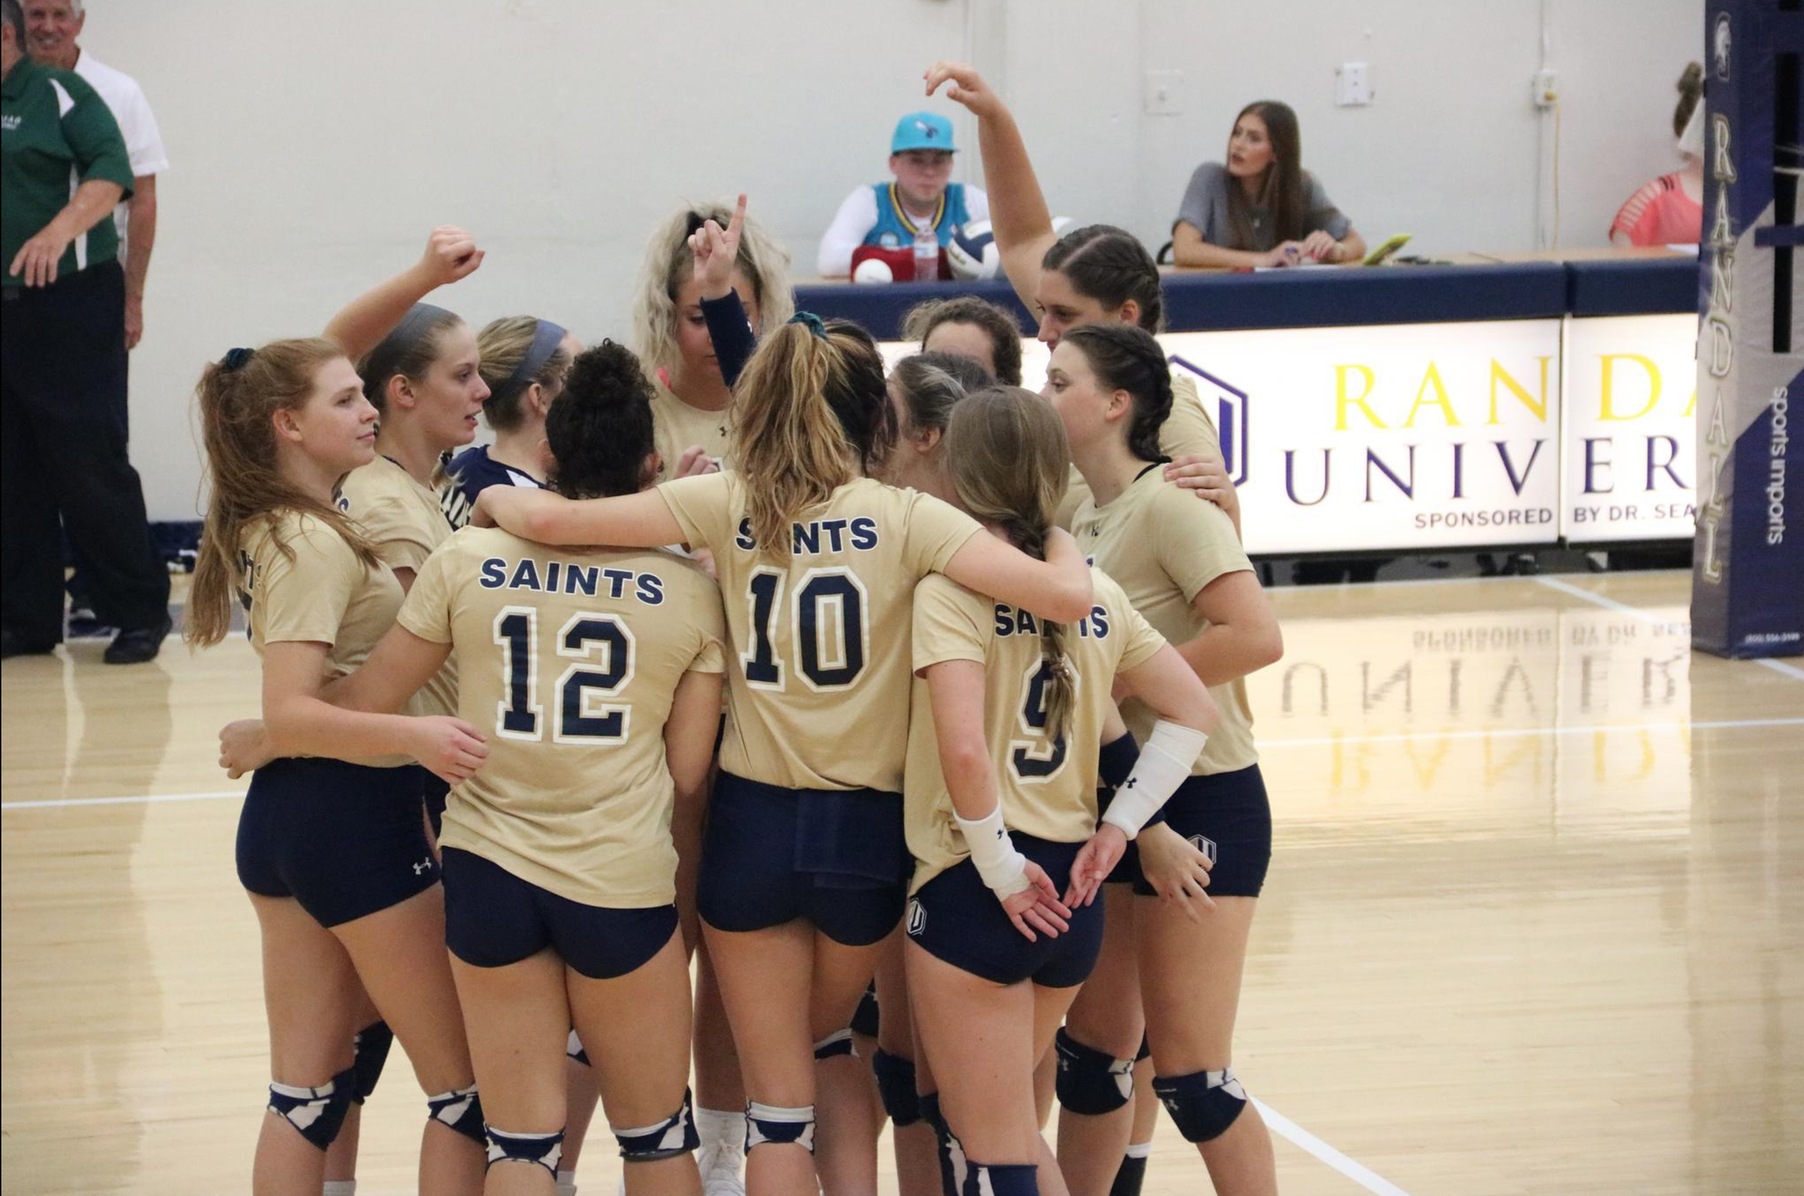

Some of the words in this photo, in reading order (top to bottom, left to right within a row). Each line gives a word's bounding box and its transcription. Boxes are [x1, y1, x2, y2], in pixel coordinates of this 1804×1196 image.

[1704, 113, 1737, 583] RANDALL
[1770, 386, 1789, 457] sports
[735, 516, 878, 555] SNTS
[1415, 508, 1552, 528] SPONSORED
[1573, 506, 1601, 524] BY
[1766, 459, 1786, 544] imports
[479, 557, 665, 606] SAINTS
[739, 565, 870, 693] 10
[493, 605, 636, 746] 12
[1006, 652, 1081, 785] 9
